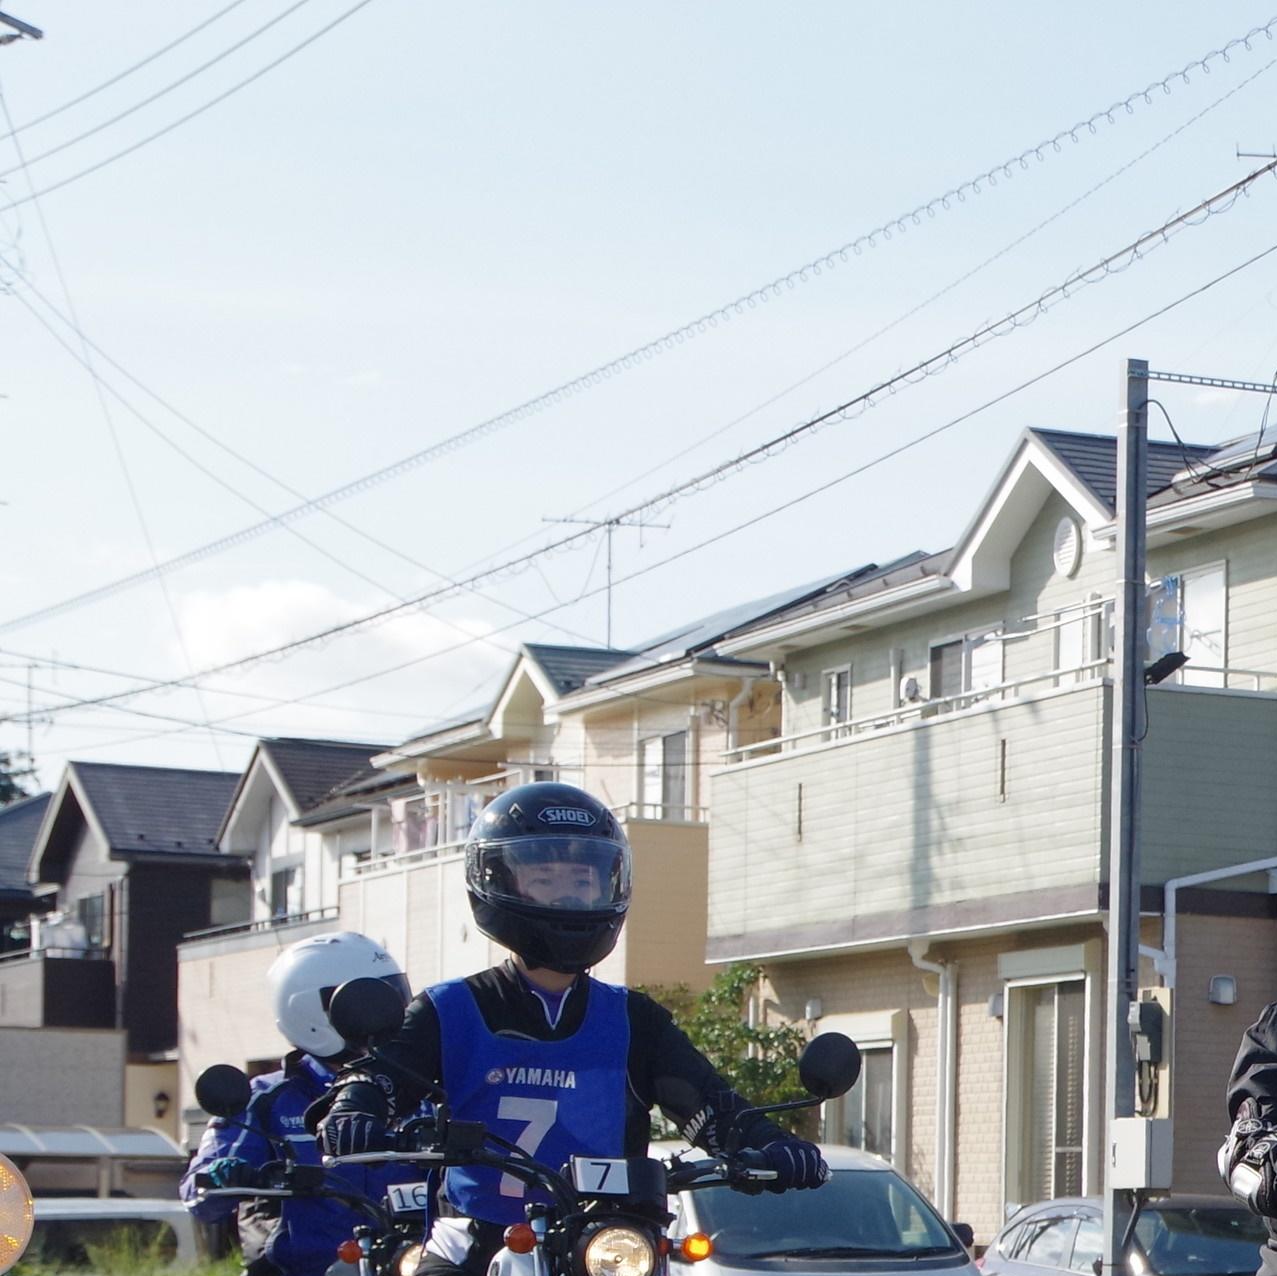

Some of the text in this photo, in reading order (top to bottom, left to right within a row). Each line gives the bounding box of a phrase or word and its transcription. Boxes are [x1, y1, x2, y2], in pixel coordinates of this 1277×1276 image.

[546, 809, 591, 824] SHOEI
[506, 1067, 576, 1088] YAMAHA
[497, 1096, 558, 1198] 7
[590, 1162, 611, 1190] 7
[392, 1185, 427, 1209] 16
